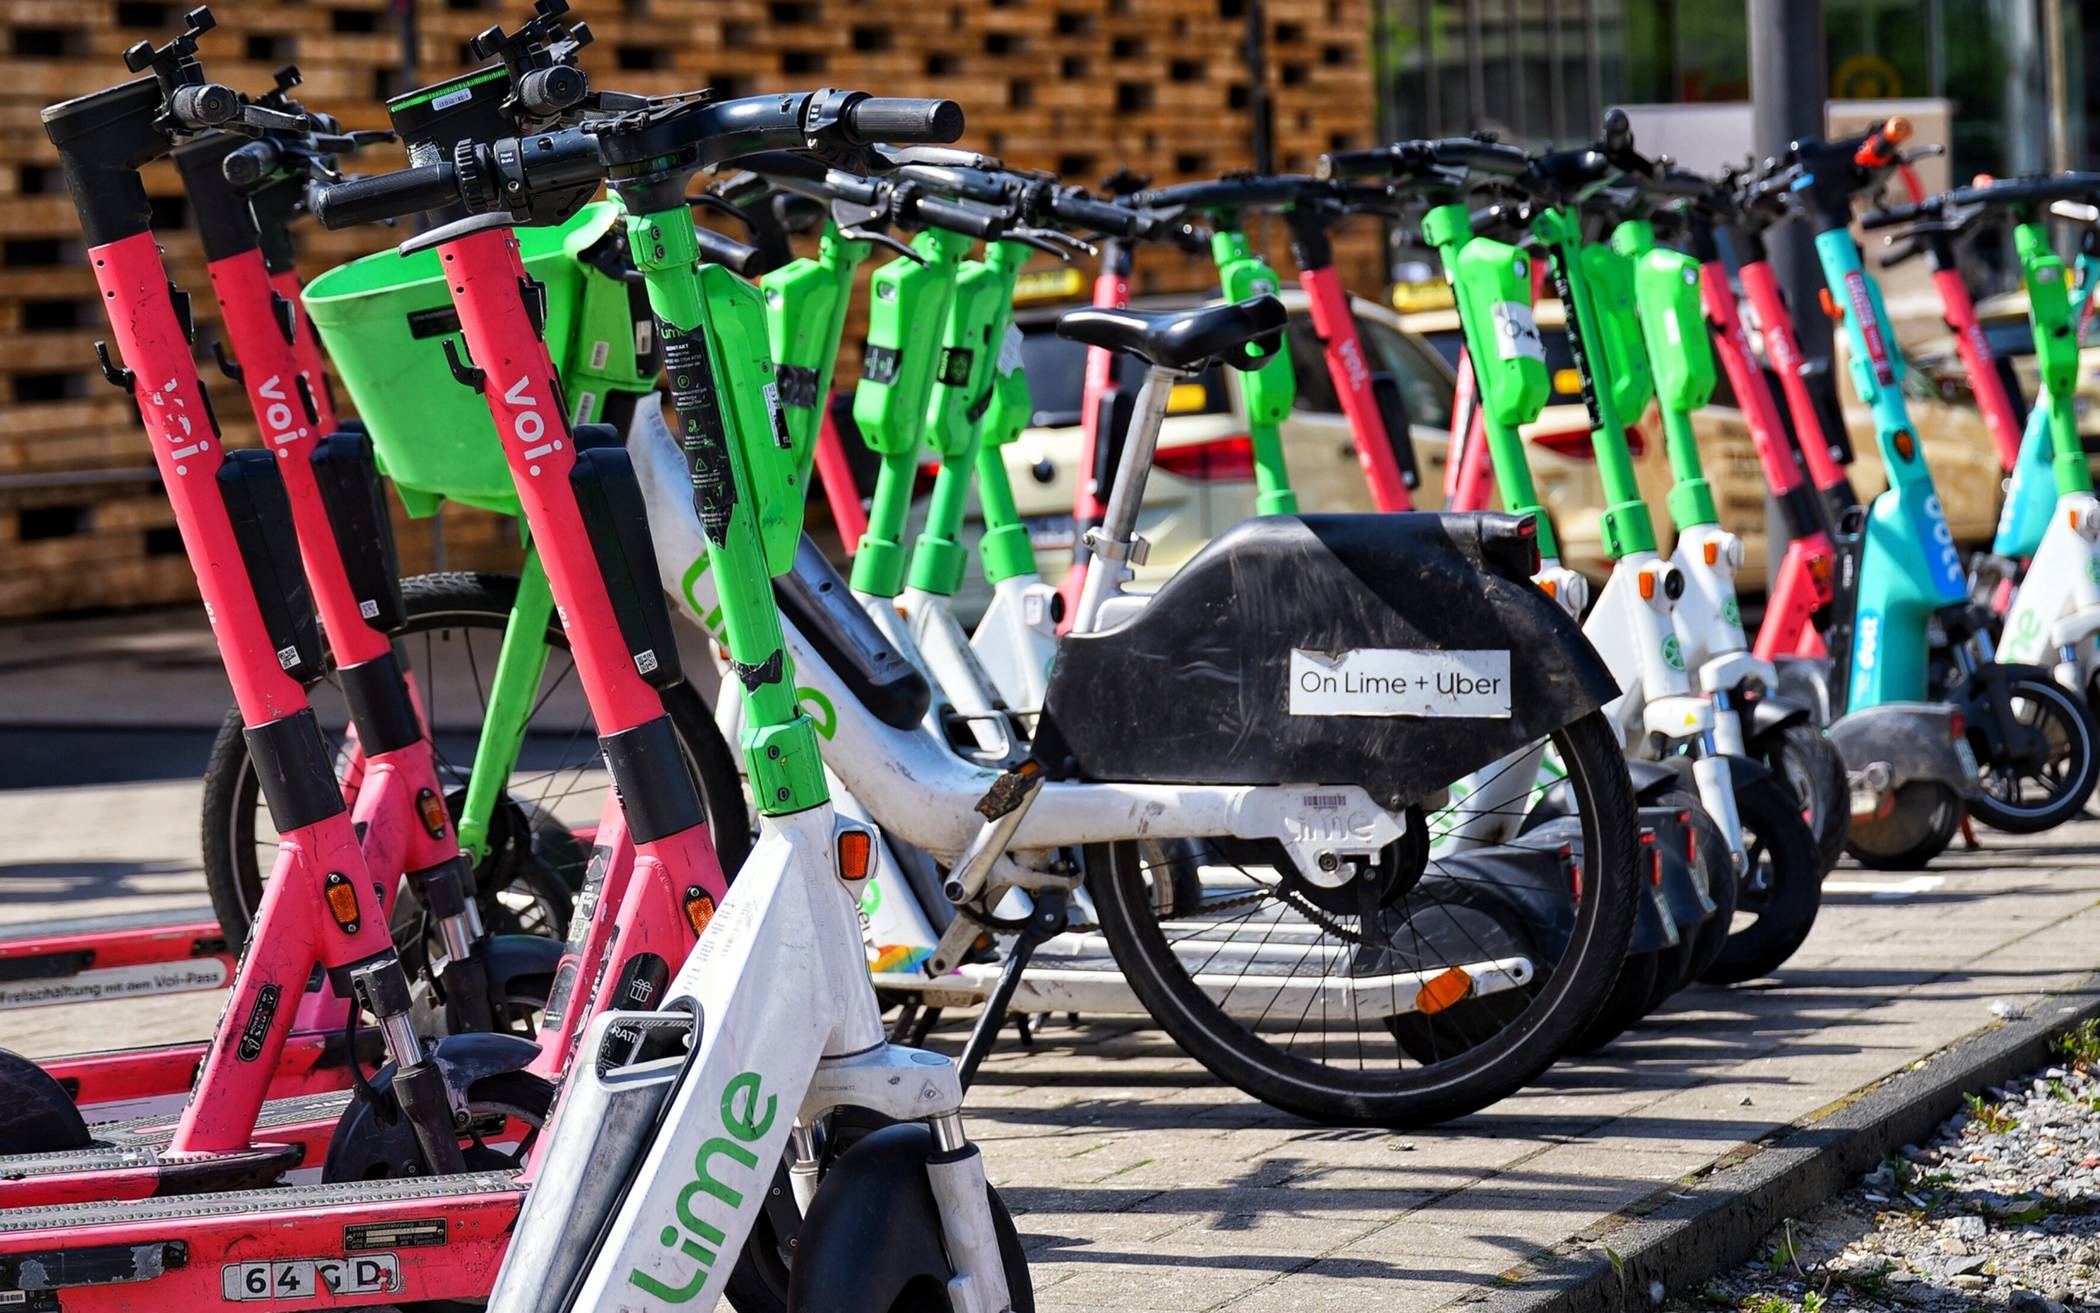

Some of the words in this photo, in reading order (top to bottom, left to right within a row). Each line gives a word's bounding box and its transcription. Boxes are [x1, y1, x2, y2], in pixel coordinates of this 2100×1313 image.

[259, 375, 308, 458] voi.
[505, 375, 563, 477] voi.
[1301, 672, 1336, 694] On
[1345, 672, 1407, 694] Lime
[1415, 676, 1428, 691] +
[1437, 672, 1502, 695] Uber
[105, 982, 124, 993] mit
[126, 980, 152, 992] dem
[154, 971, 220, 989] Voi-Pass
[629, 1072, 778, 1304] Lime
